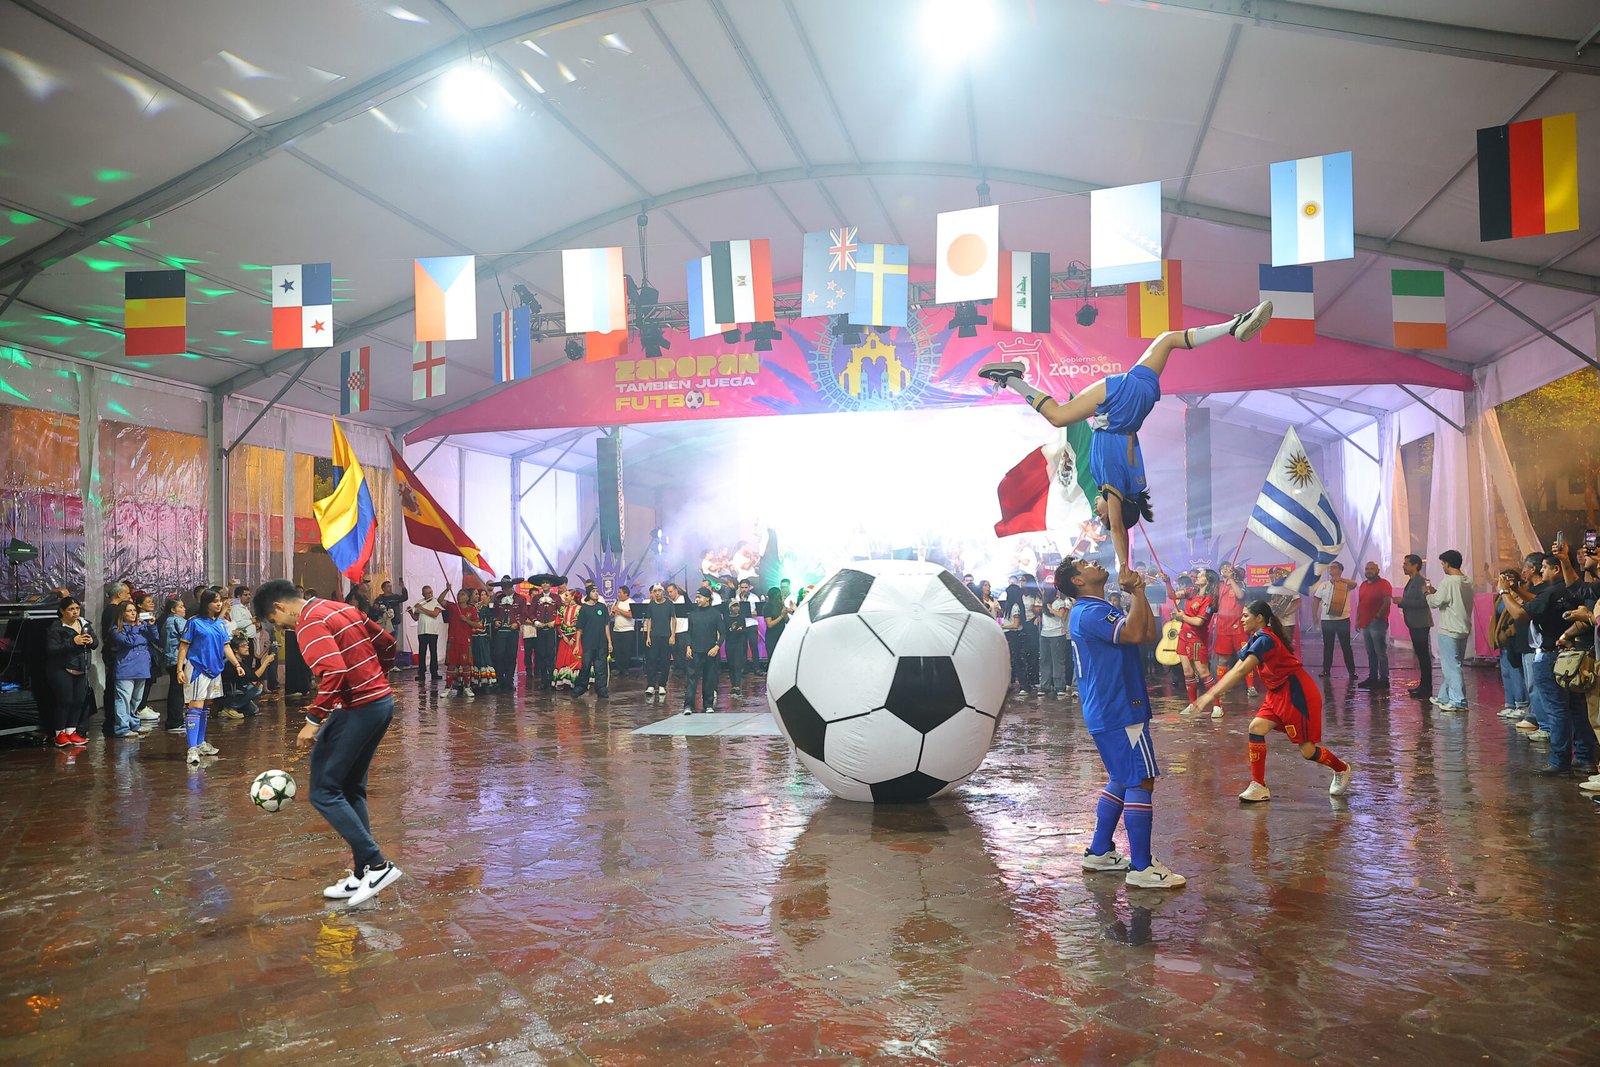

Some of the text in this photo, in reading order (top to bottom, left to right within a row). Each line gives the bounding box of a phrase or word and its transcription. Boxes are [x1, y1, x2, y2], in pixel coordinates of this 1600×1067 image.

[1060, 354, 1108, 365] Gobierno de
[1049, 362, 1122, 378] Zapopan
[615, 376, 756, 393] TAMBIÉN JUEGA
